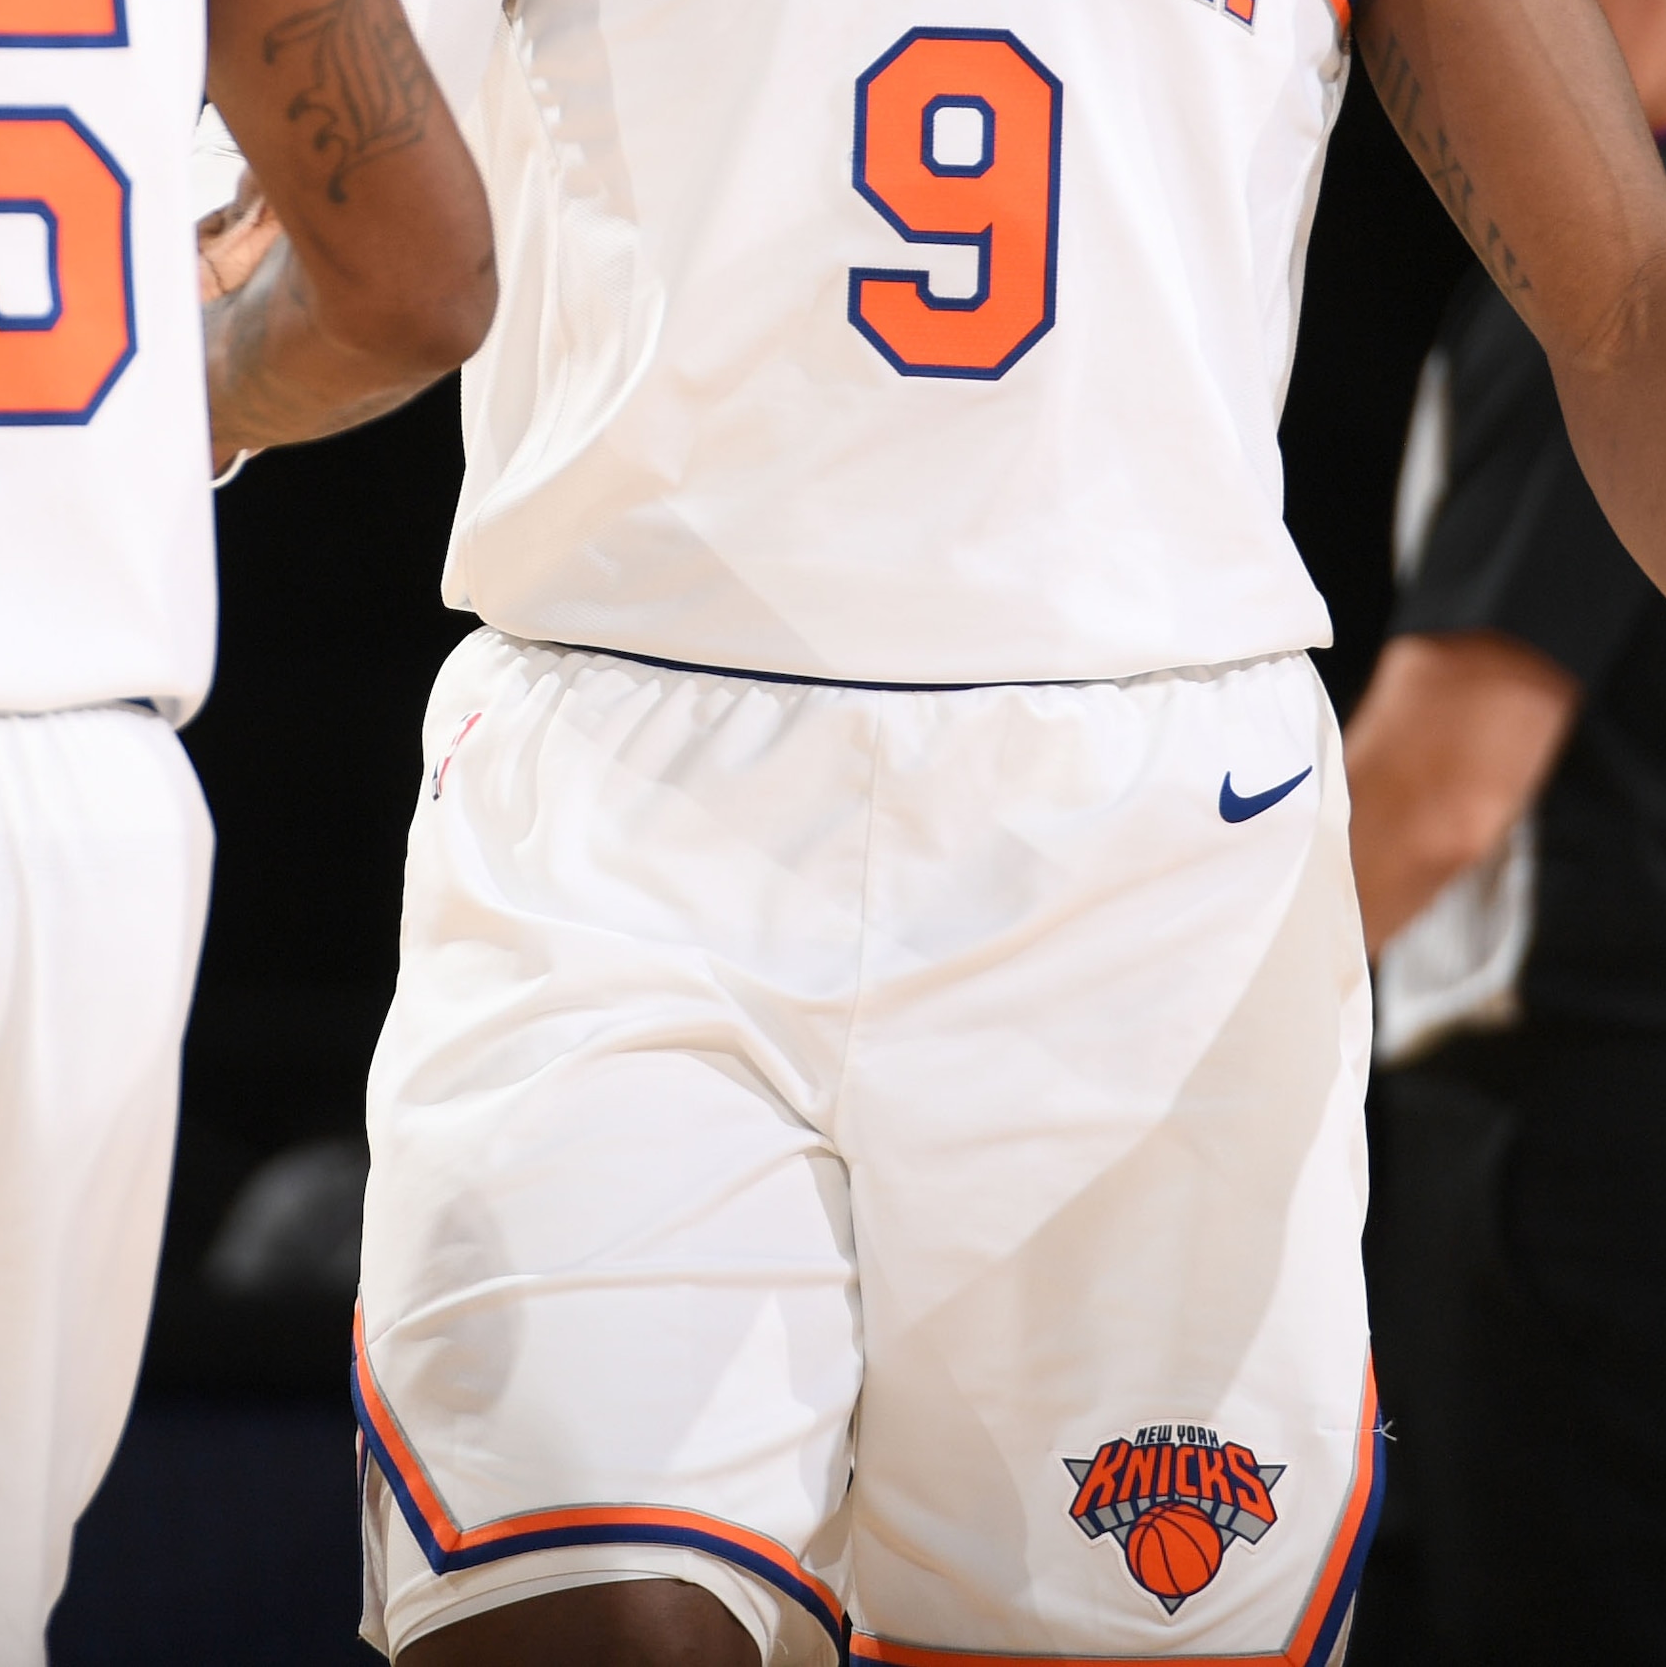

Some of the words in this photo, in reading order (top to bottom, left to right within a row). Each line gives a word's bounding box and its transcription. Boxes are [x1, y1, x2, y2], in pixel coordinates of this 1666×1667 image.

[847, 26, 1063, 380] 9
[1134, 1424, 1173, 1445] NEW
[1176, 1424, 1220, 1448] YORK
[1069, 1437, 1278, 1523] KNICKS
